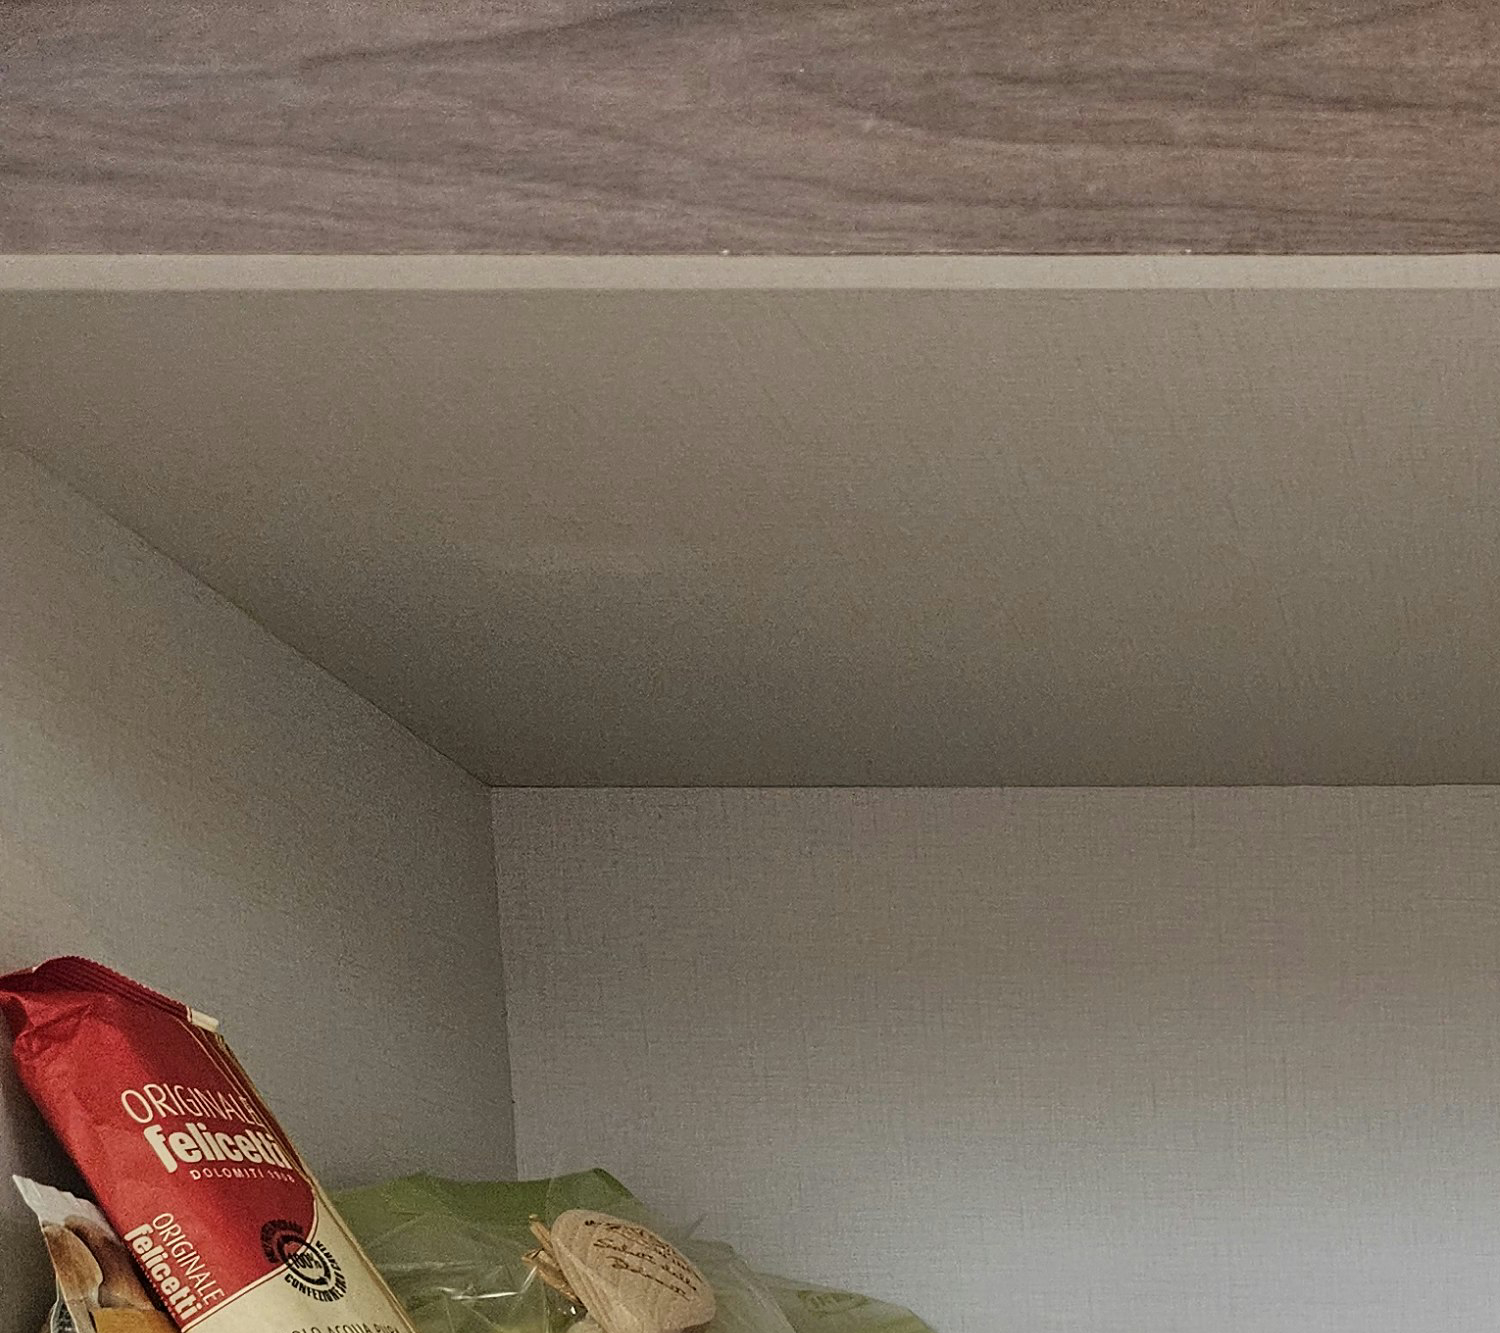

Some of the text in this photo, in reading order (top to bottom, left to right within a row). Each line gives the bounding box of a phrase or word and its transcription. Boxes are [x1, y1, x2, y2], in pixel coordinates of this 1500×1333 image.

[121, 1083, 265, 1127] ORIGINALE
[143, 1122, 293, 1174] felicetti
[190, 1167, 264, 1181] DOLOMITI
[123, 1222, 203, 1321] felicetti
[152, 1212, 225, 1306] ORIGINALE
